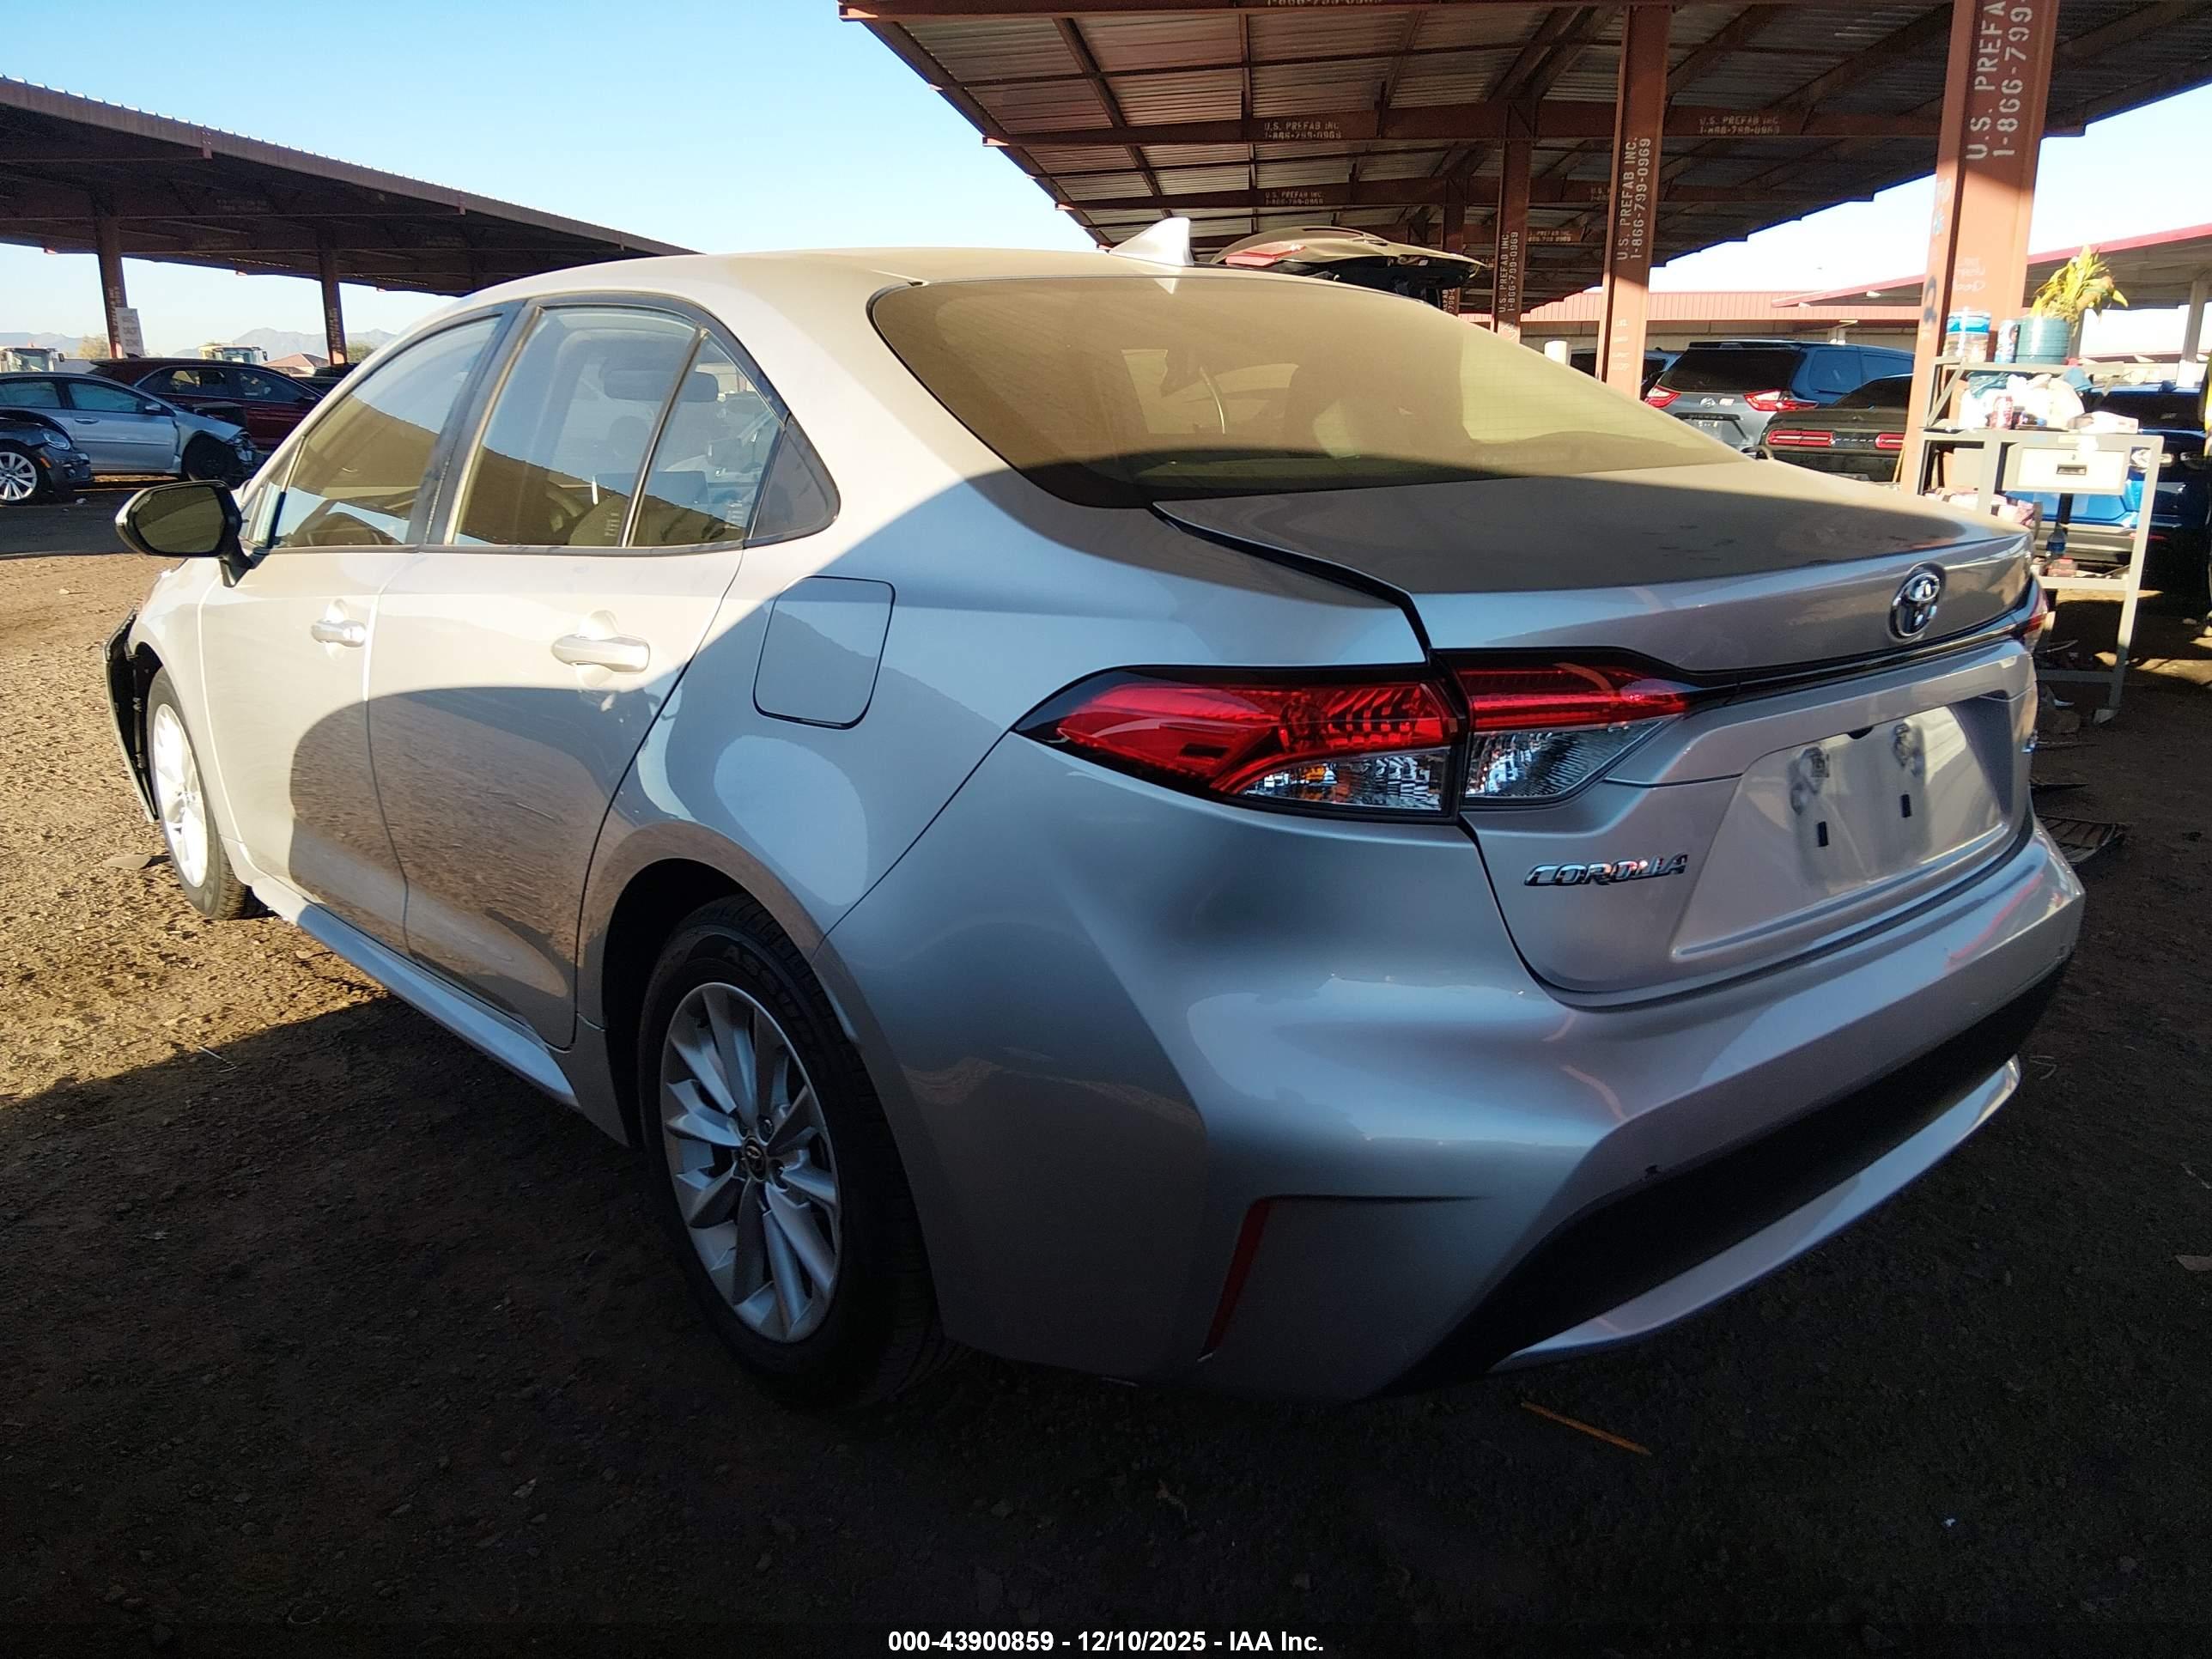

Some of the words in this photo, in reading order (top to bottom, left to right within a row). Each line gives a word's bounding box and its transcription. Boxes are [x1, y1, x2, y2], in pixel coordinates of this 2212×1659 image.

[1992, 0, 2033, 157] 1-866-799
[1624, 137, 1638, 165] INC.
[1966, 108, 1993, 160] U.S.
[1620, 171, 1635, 226] PREFAB
[1630, 138, 1651, 259] 1-866-799-0969
[1617, 234, 1631, 261] U.S.
[1498, 253, 1509, 290] PREFAB
[1524, 852, 1689, 886] COROLLA
